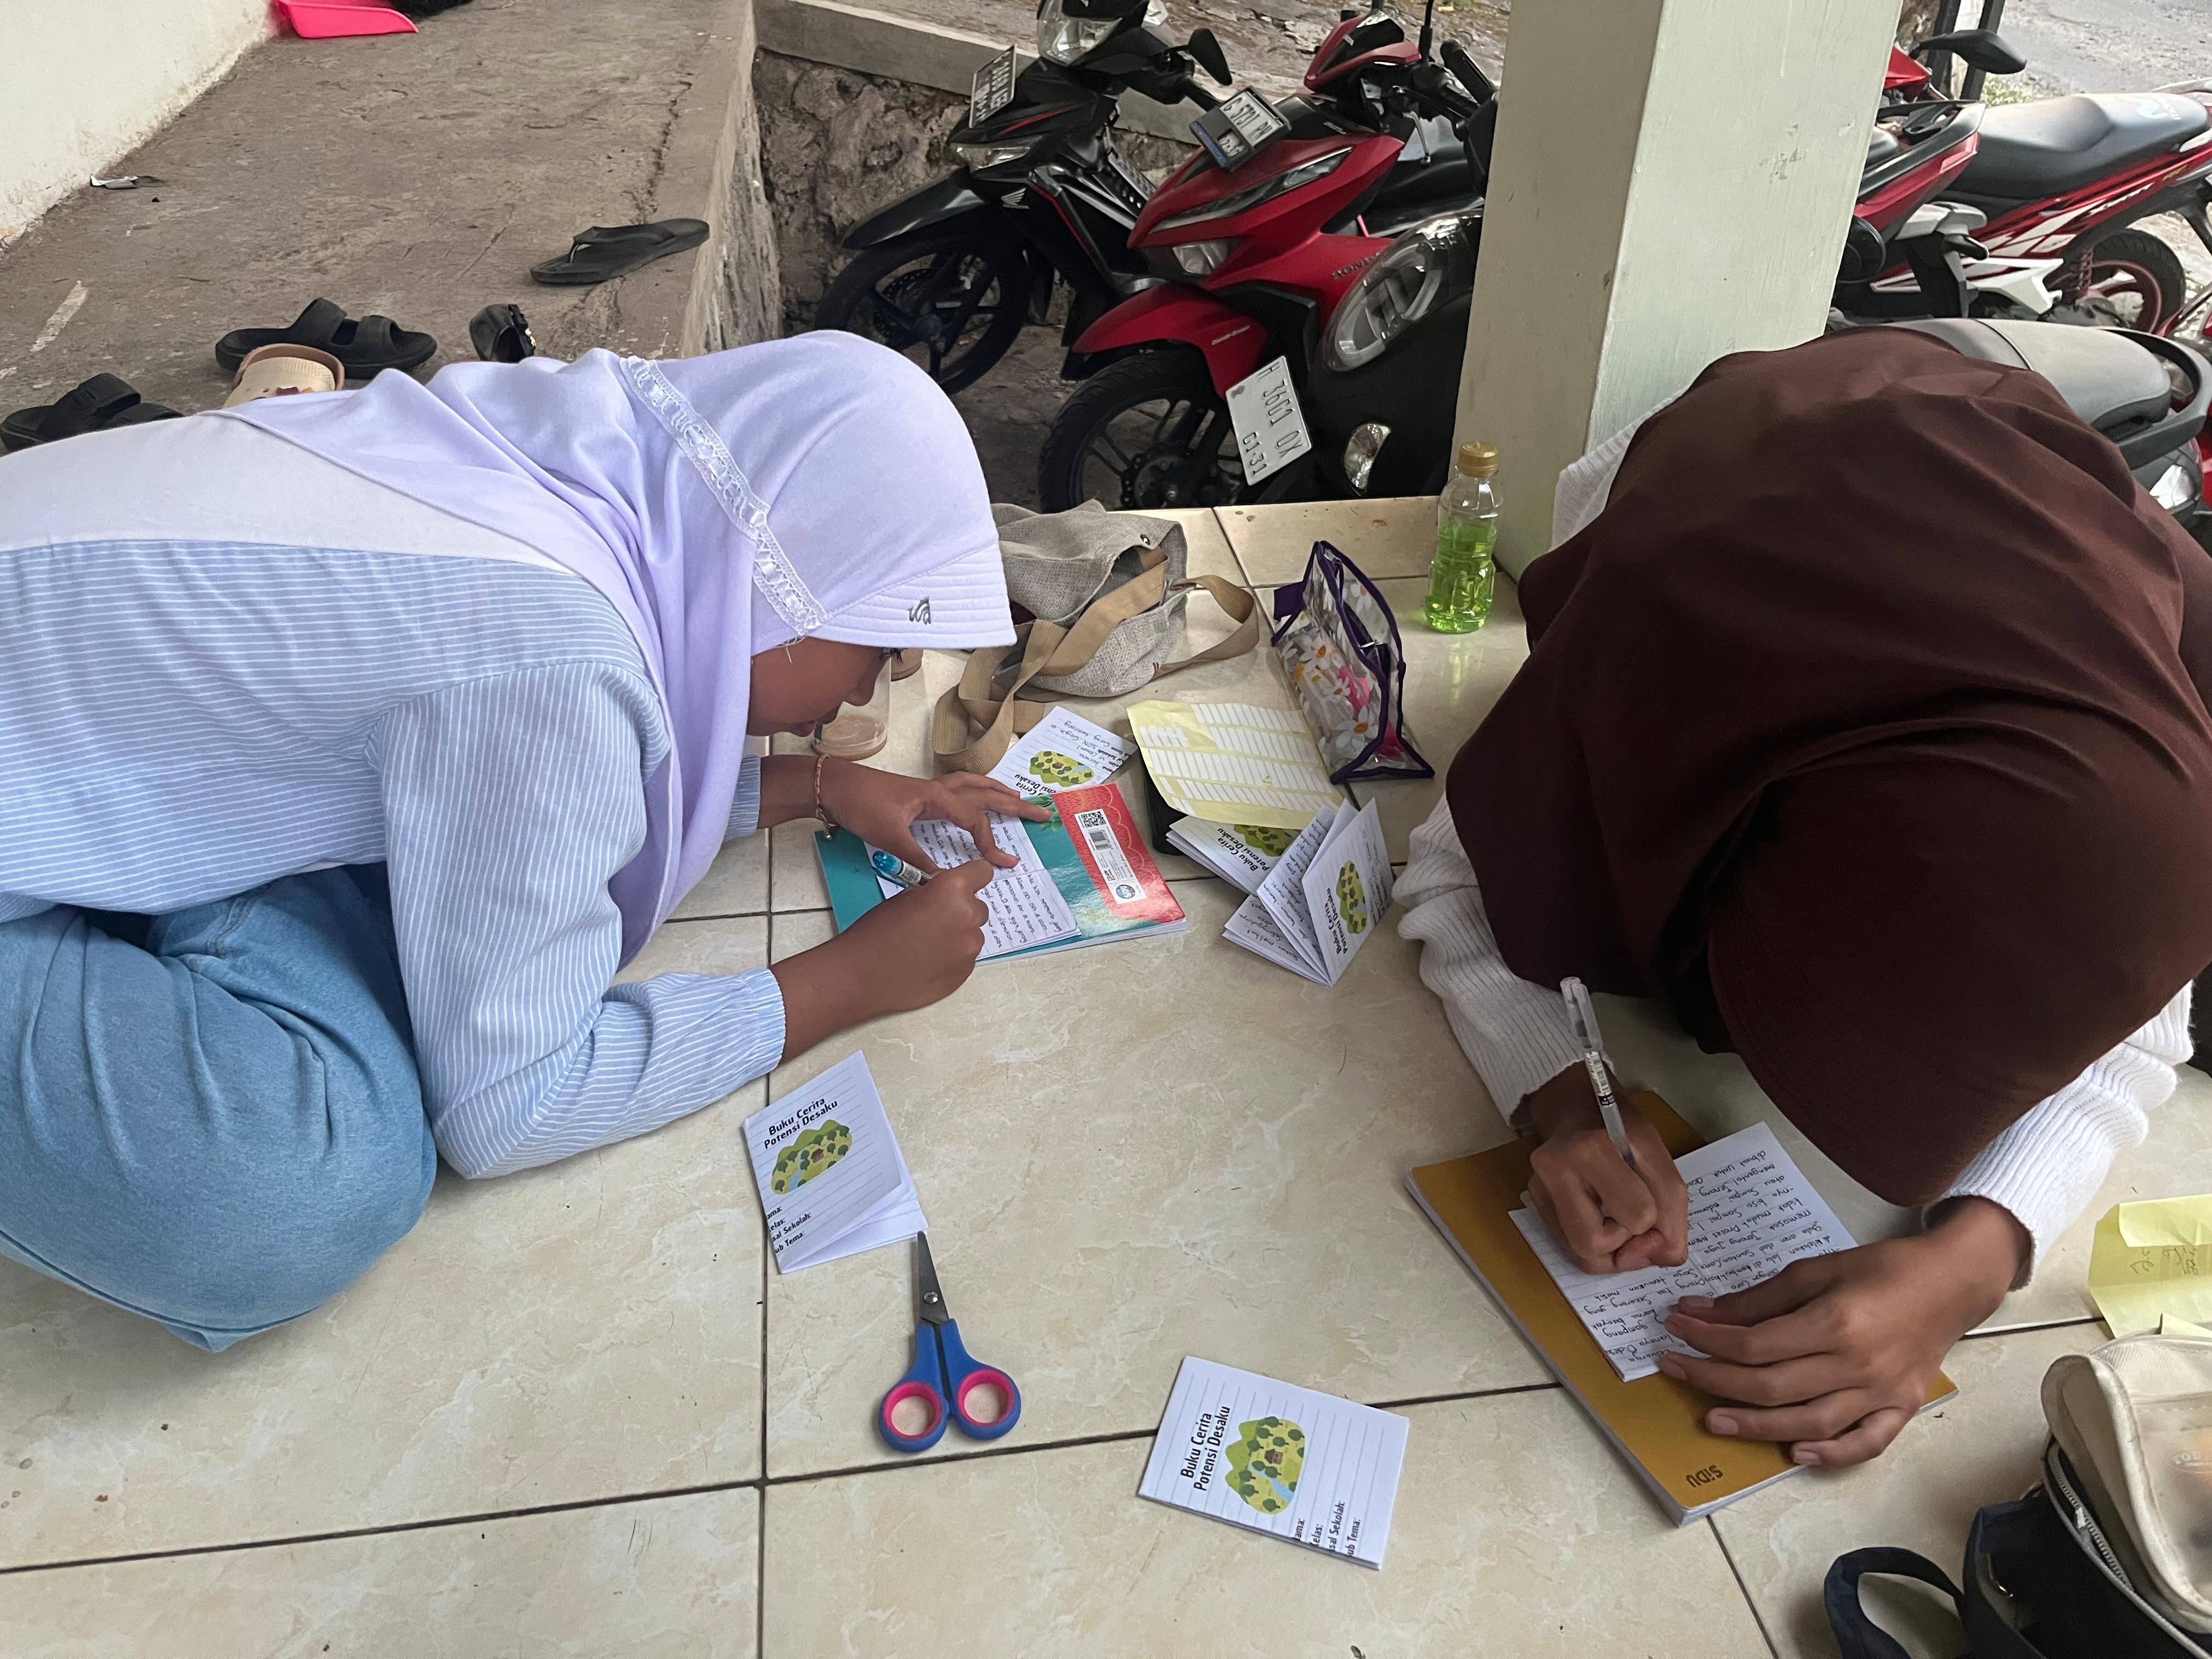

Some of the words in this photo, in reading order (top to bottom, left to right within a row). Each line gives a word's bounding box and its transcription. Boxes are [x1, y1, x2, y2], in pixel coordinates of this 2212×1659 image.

[1257, 361, 1280, 381] H
[1014, 774, 1041, 789] Desaku
[1015, 782, 1037, 795] Cerita
[1217, 827, 1244, 849] Desaku
[1217, 837, 1239, 855] Cerita
[1238, 854, 1259, 871] Buku
[1241, 848, 1271, 871] Potensi
[1326, 887, 1338, 921] Desaku
[1324, 902, 1334, 930] Cerita
[1331, 929, 1342, 954] Buku
[1335, 919, 1348, 954] Potensi
[764, 1121, 800, 1149] Potensi
[802, 1101, 837, 1126] Desaku
[768, 1116, 794, 1136] Buku
[796, 1098, 825, 1119] Cerita
[1739, 1150, 1766, 1167] dibuat
[1763, 1175, 1785, 1186] atau
[1746, 1198, 1768, 1207] bisa
[1778, 1197, 1803, 1212] tidak
[766, 1206, 782, 1220] ama:
[1741, 1210, 1771, 1228] mudah
[1768, 1209, 1811, 1231] memasak
[768, 1217, 786, 1232] elas:
[771, 1230, 782, 1242] sal
[782, 1212, 811, 1234] Sekolah:
[773, 1244, 784, 1254] ub
[784, 1231, 805, 1246] Tema:
[1764, 1252, 1782, 1264] lalu
[1628, 1276, 1667, 1291] temukan
[1594, 1290, 1620, 1301] masih
[1583, 1299, 1606, 1314] yang
[1590, 1317, 1626, 1330] banyak
[1601, 1314, 1648, 1338] gampang
[1190, 1413, 1212, 1445] Cerita
[1193, 1447, 1217, 1491] Potensi
[1206, 1406, 1230, 1446] Desaku
[1180, 1448, 1201, 1478] Buku
[1329, 1500, 1345, 1535] Sekolah:
[1346, 1518, 1361, 1542] Tema:
[1327, 1536, 1337, 1551] sal
[1344, 1544, 1355, 1556] ub
